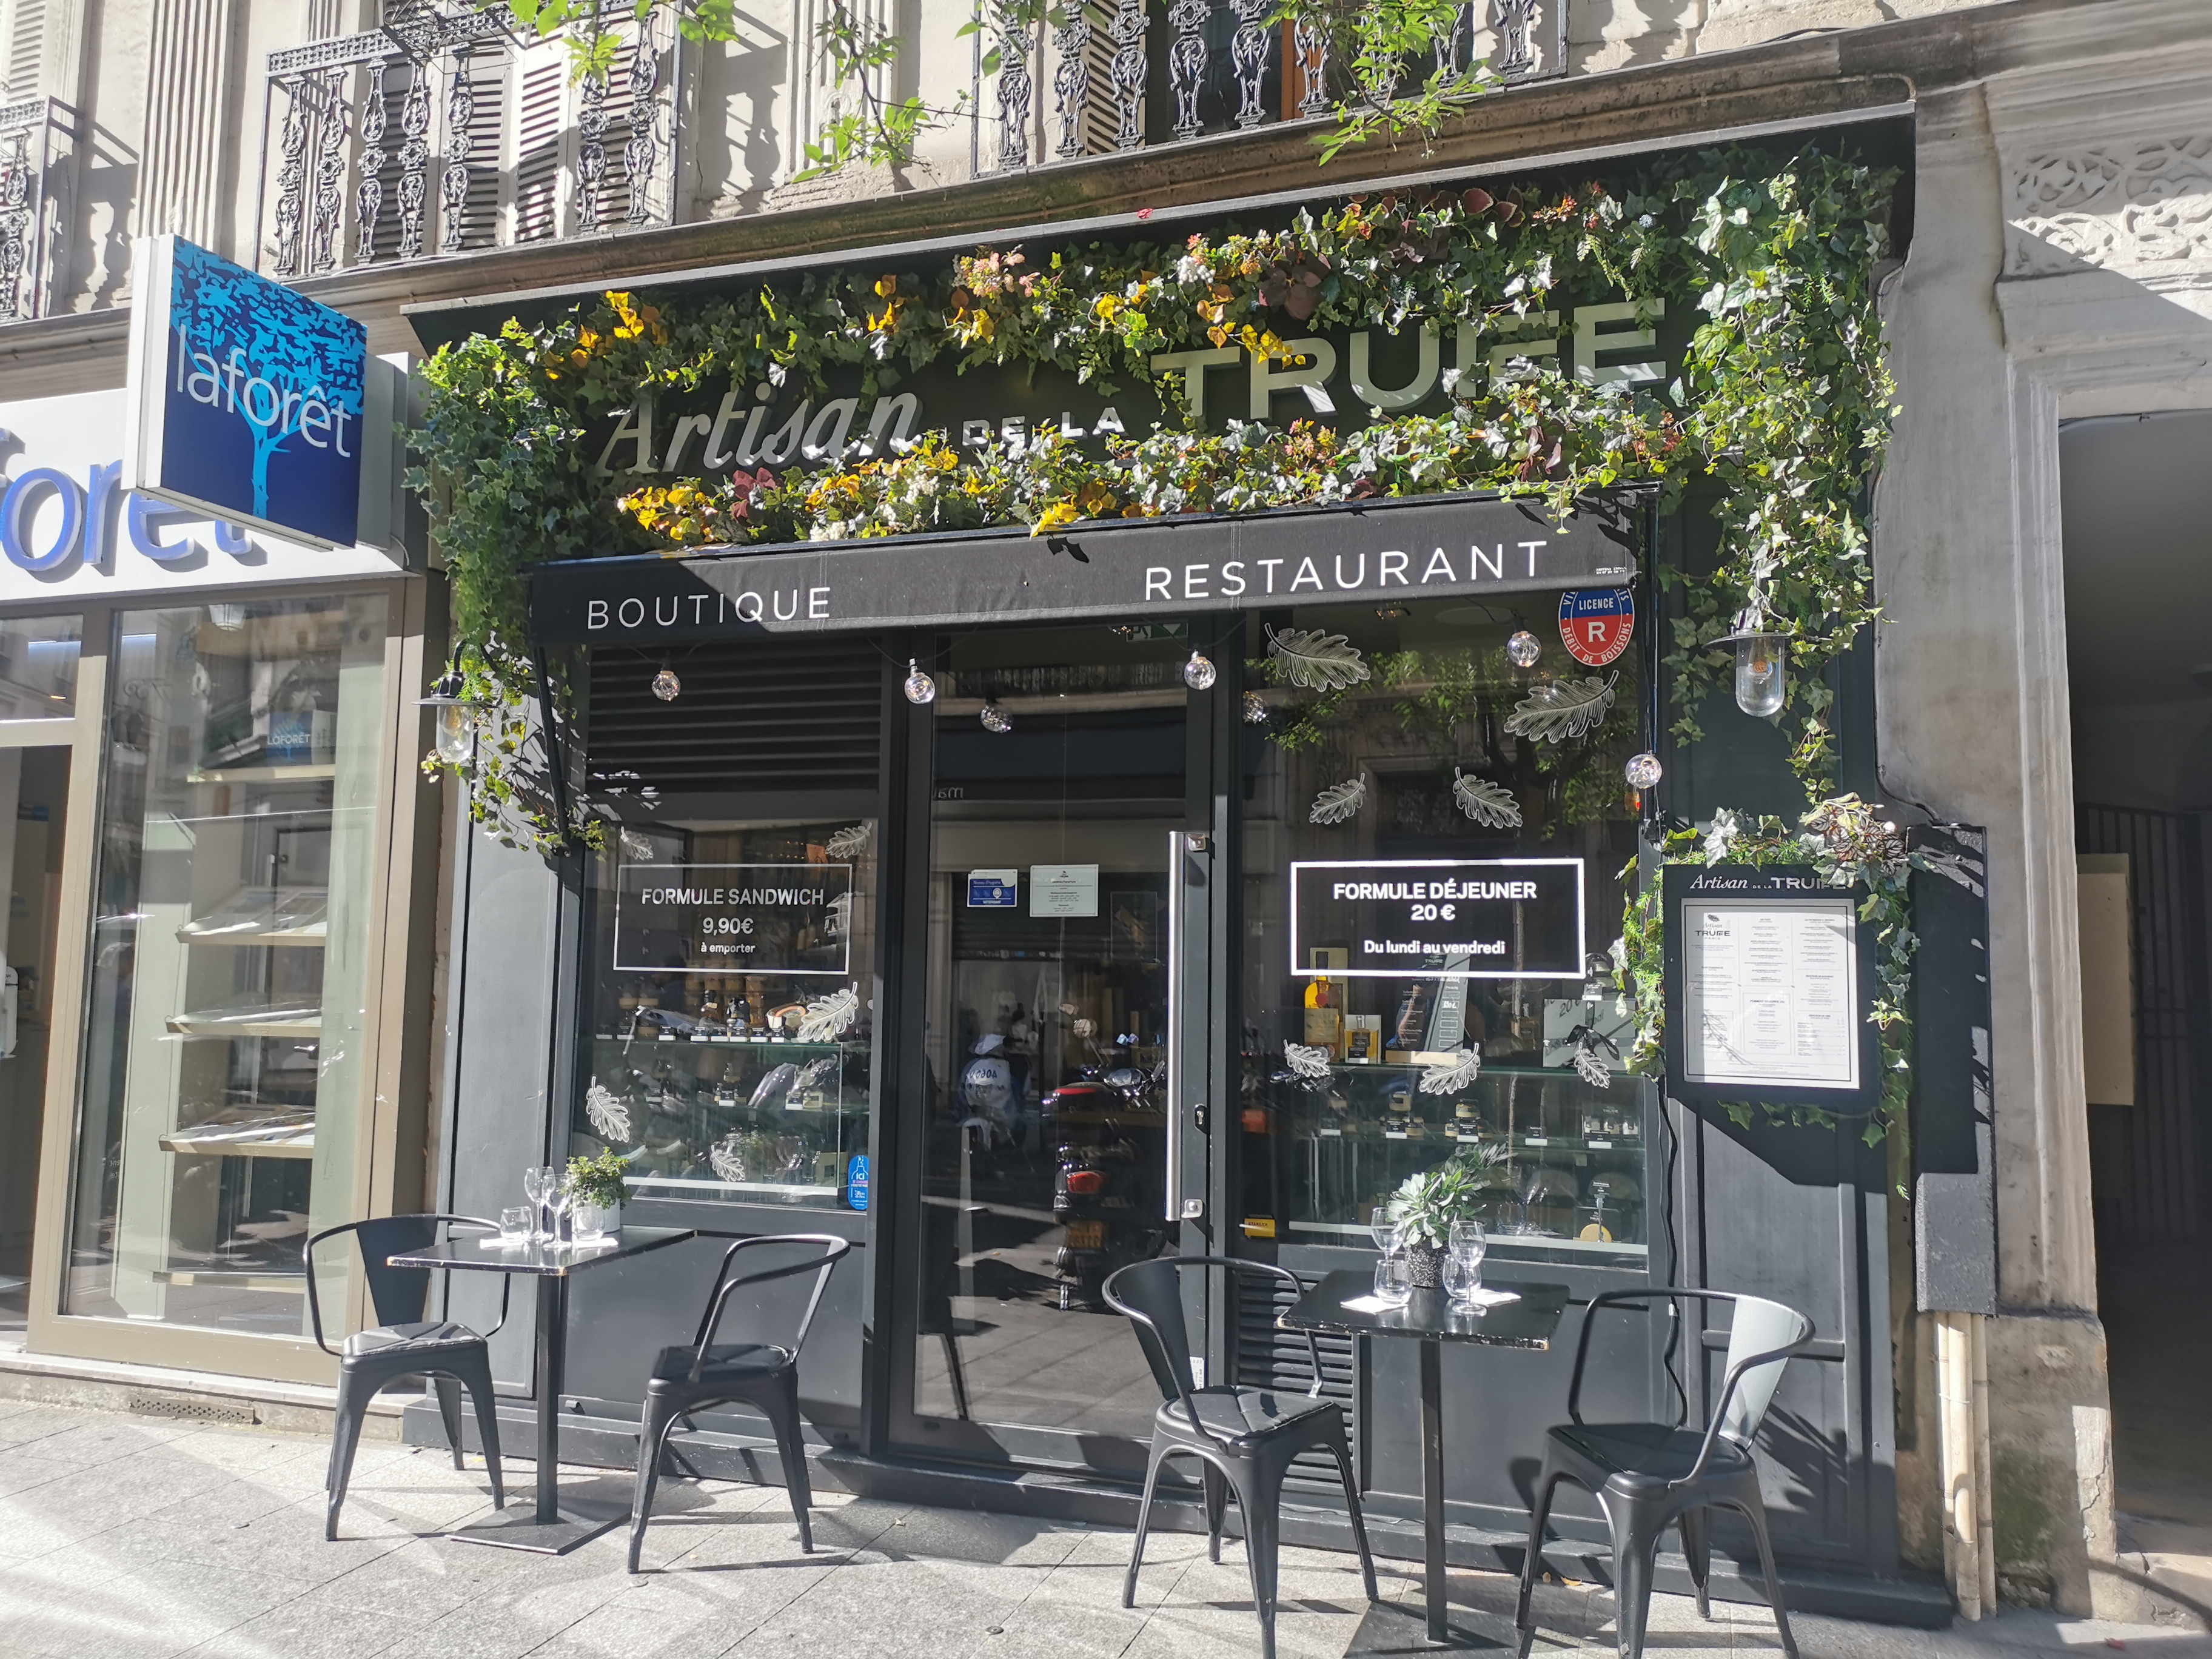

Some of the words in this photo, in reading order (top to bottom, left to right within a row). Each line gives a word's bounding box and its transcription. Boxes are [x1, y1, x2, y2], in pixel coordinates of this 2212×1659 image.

[178, 324, 352, 458] laforêt
[592, 381, 923, 476] Artisan
[962, 416, 1026, 446] DE
[1061, 407, 1127, 438] LA
[587, 586, 831, 629] BOUTIQUE
[1145, 540, 1547, 601] RESTAURANT
[1578, 597, 1614, 611] LICENCE
[1587, 621, 1607, 643] R
[1562, 626, 1581, 653] DEBIT
[1582, 654, 1594, 663] DE
[1600, 623, 1632, 663] BOISSONS
[1333, 883, 1426, 900] FORMULE
[1429, 877, 1538, 899] DÉJEUNER
[1689, 874, 1748, 890] Artisan
[641, 888, 725, 905] FORMULE
[728, 888, 825, 905] SANDWICH
[1410, 903, 1438, 921] 20
[1440, 903, 1456, 921] €
[702, 917, 754, 936] 9,90€
[700, 941, 707, 953] à
[709, 943, 756, 954] emporter
[1364, 940, 1385, 954] Du
[1386, 940, 1421, 954] lundi
[1423, 943, 1442, 954] au
[1443, 940, 1506, 954] vendredi
